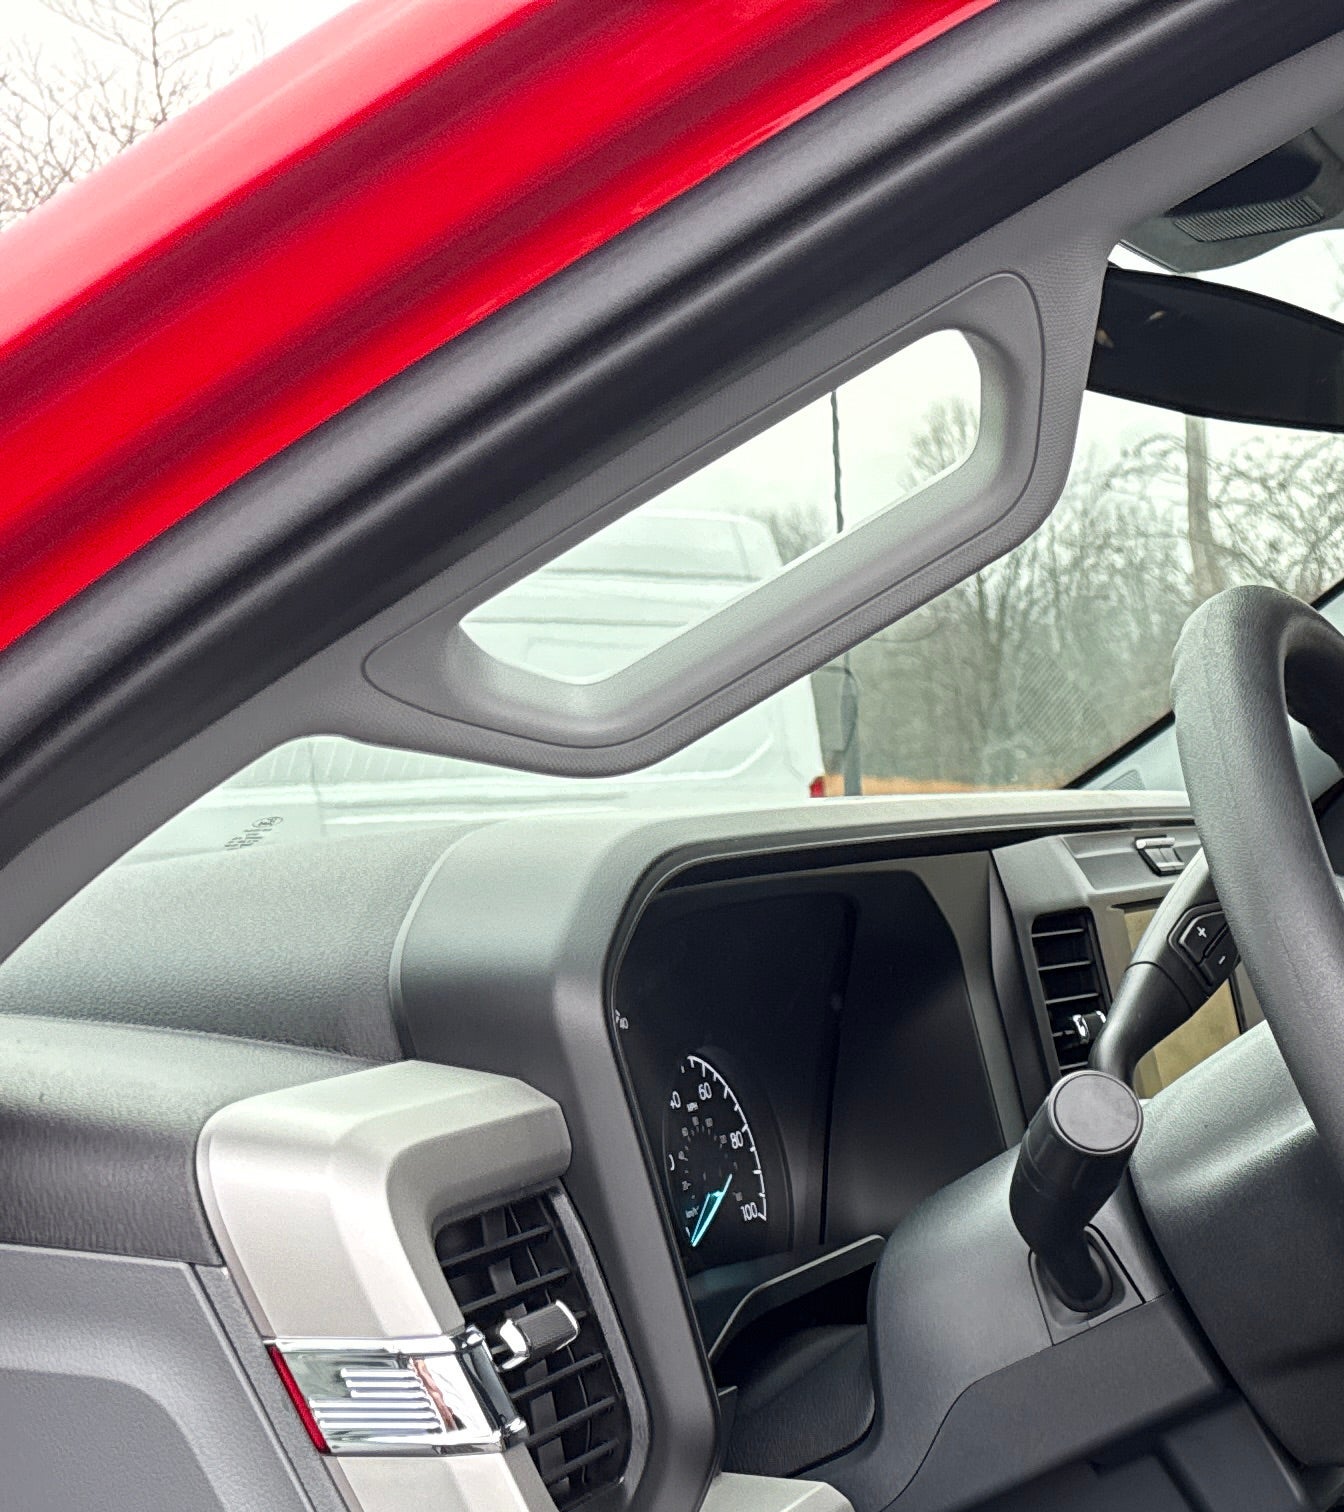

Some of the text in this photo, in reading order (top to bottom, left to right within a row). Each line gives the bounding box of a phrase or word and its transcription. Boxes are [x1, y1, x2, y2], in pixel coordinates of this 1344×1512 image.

[698, 1082, 712, 1100] 60
[730, 1130, 744, 1149] 80
[740, 1201, 758, 1221] 100
